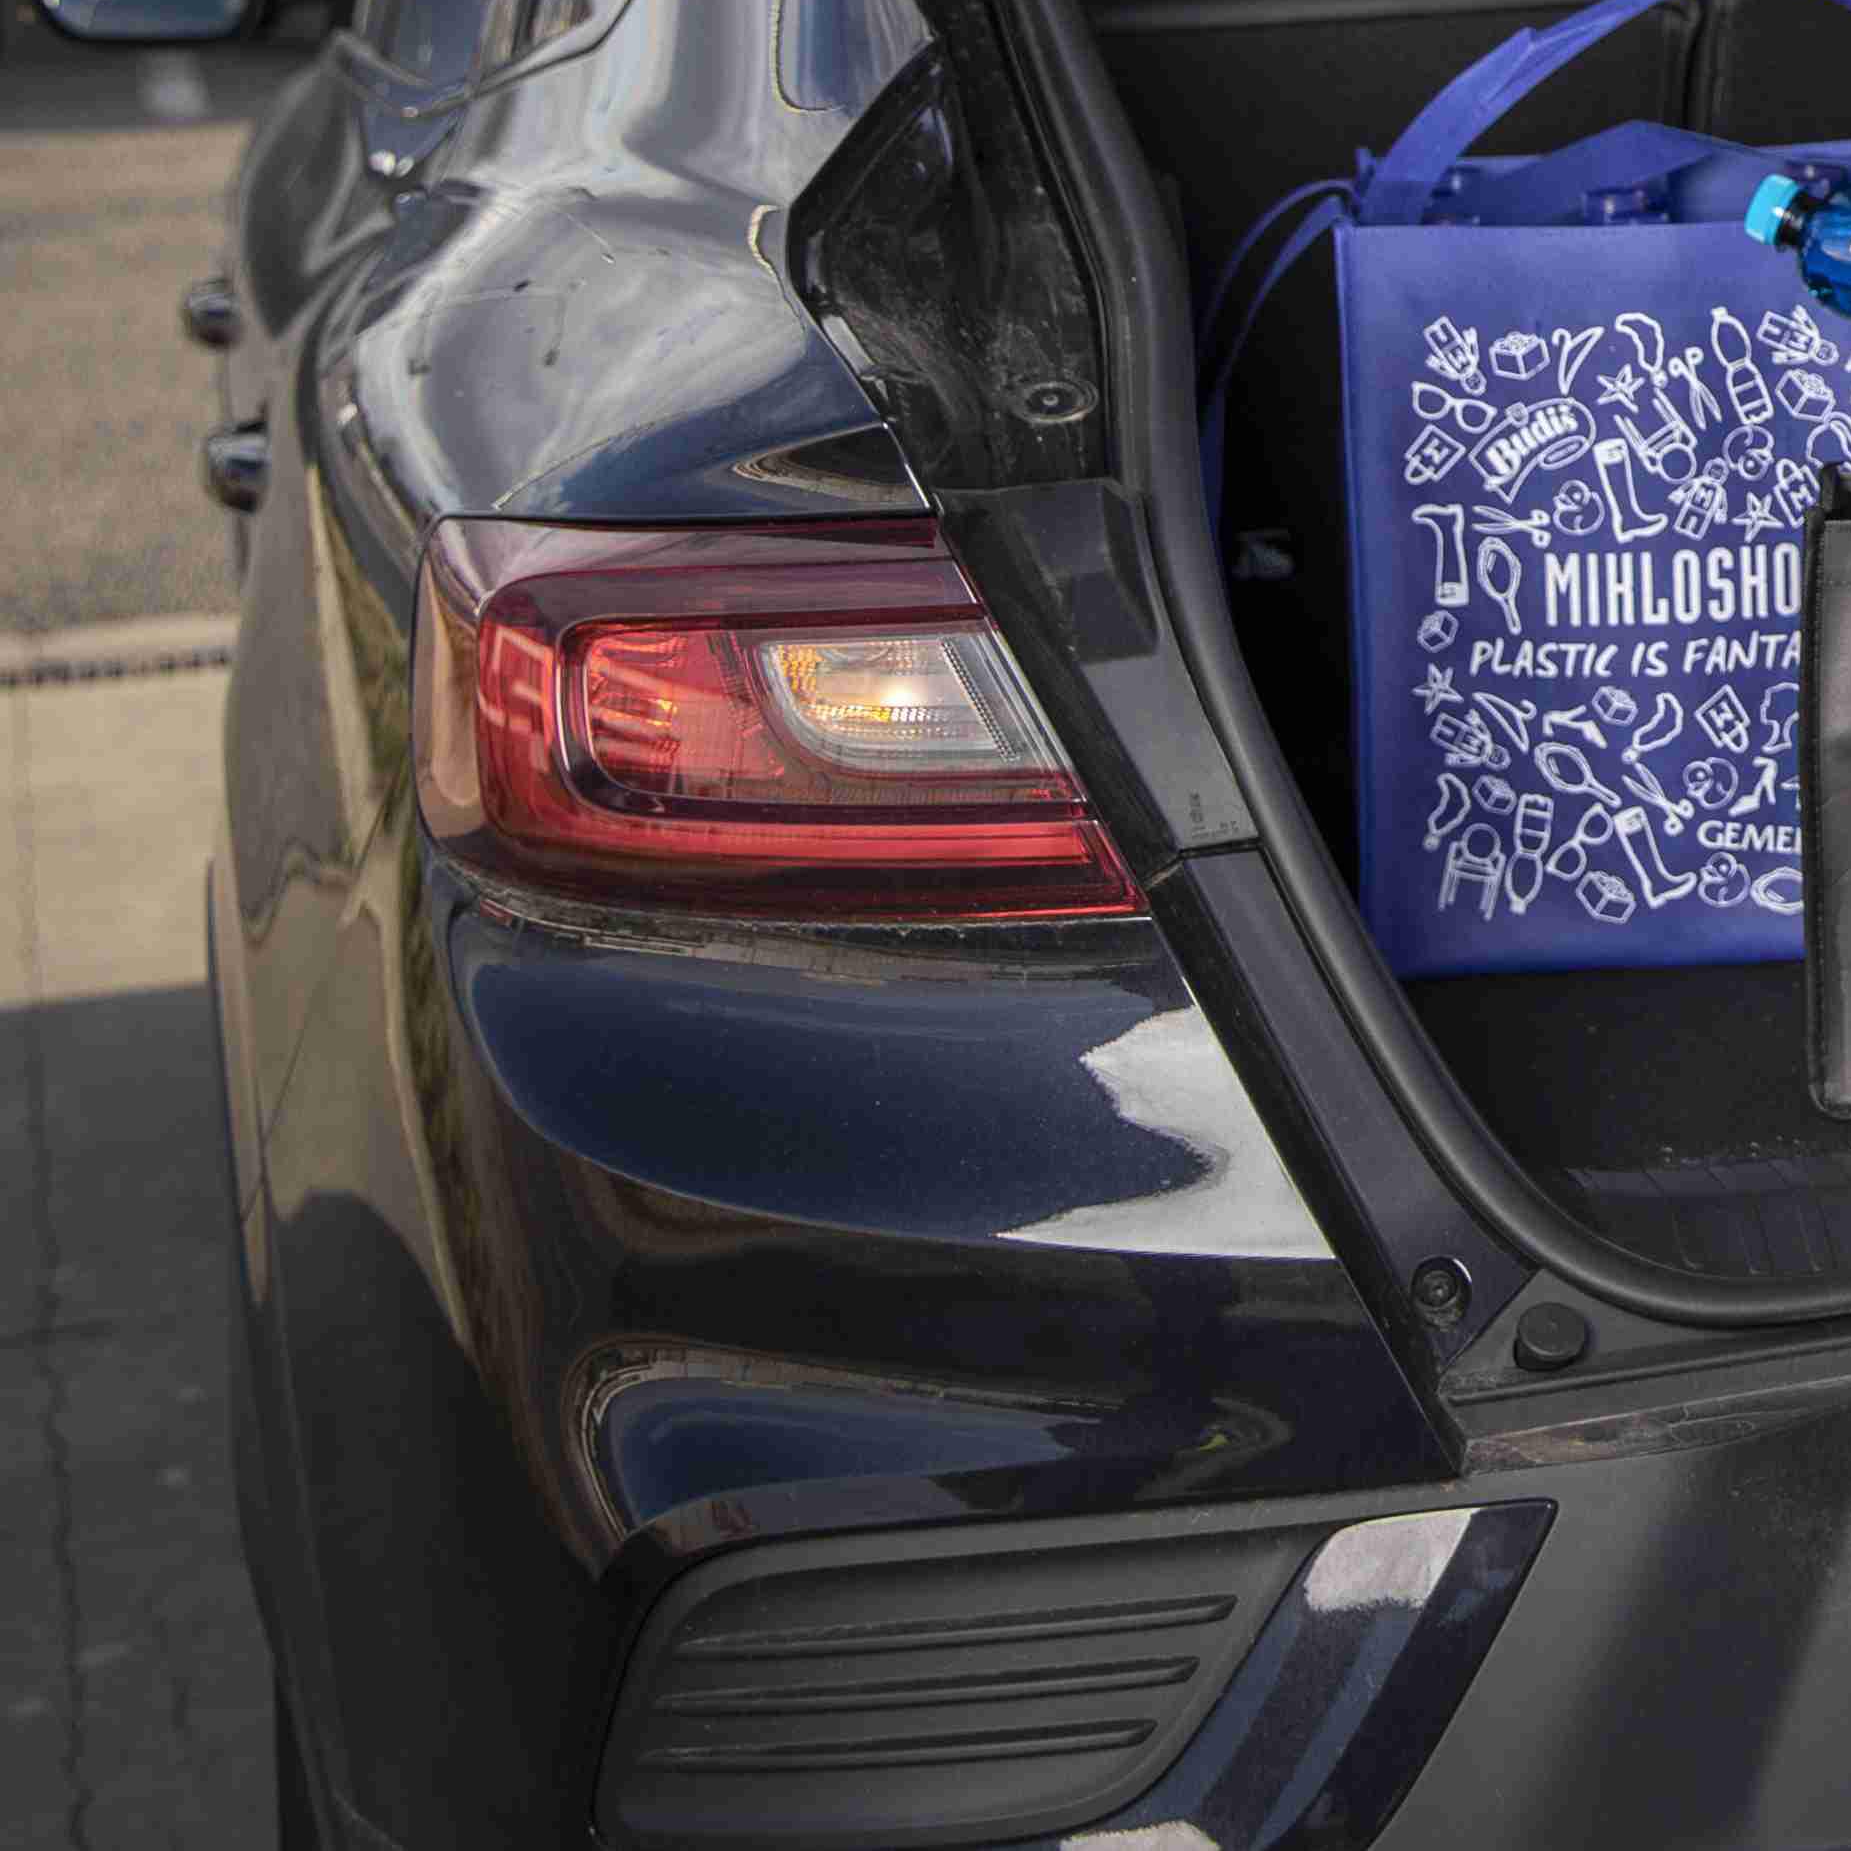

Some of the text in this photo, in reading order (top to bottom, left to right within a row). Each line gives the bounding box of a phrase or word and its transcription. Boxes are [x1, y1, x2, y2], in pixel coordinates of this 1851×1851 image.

[1545, 543, 1800, 627] MIHLOSHO
[1470, 637, 1619, 677] PLASTIC
[1631, 642, 1669, 676] IS
[1697, 820, 1800, 854] GEME
